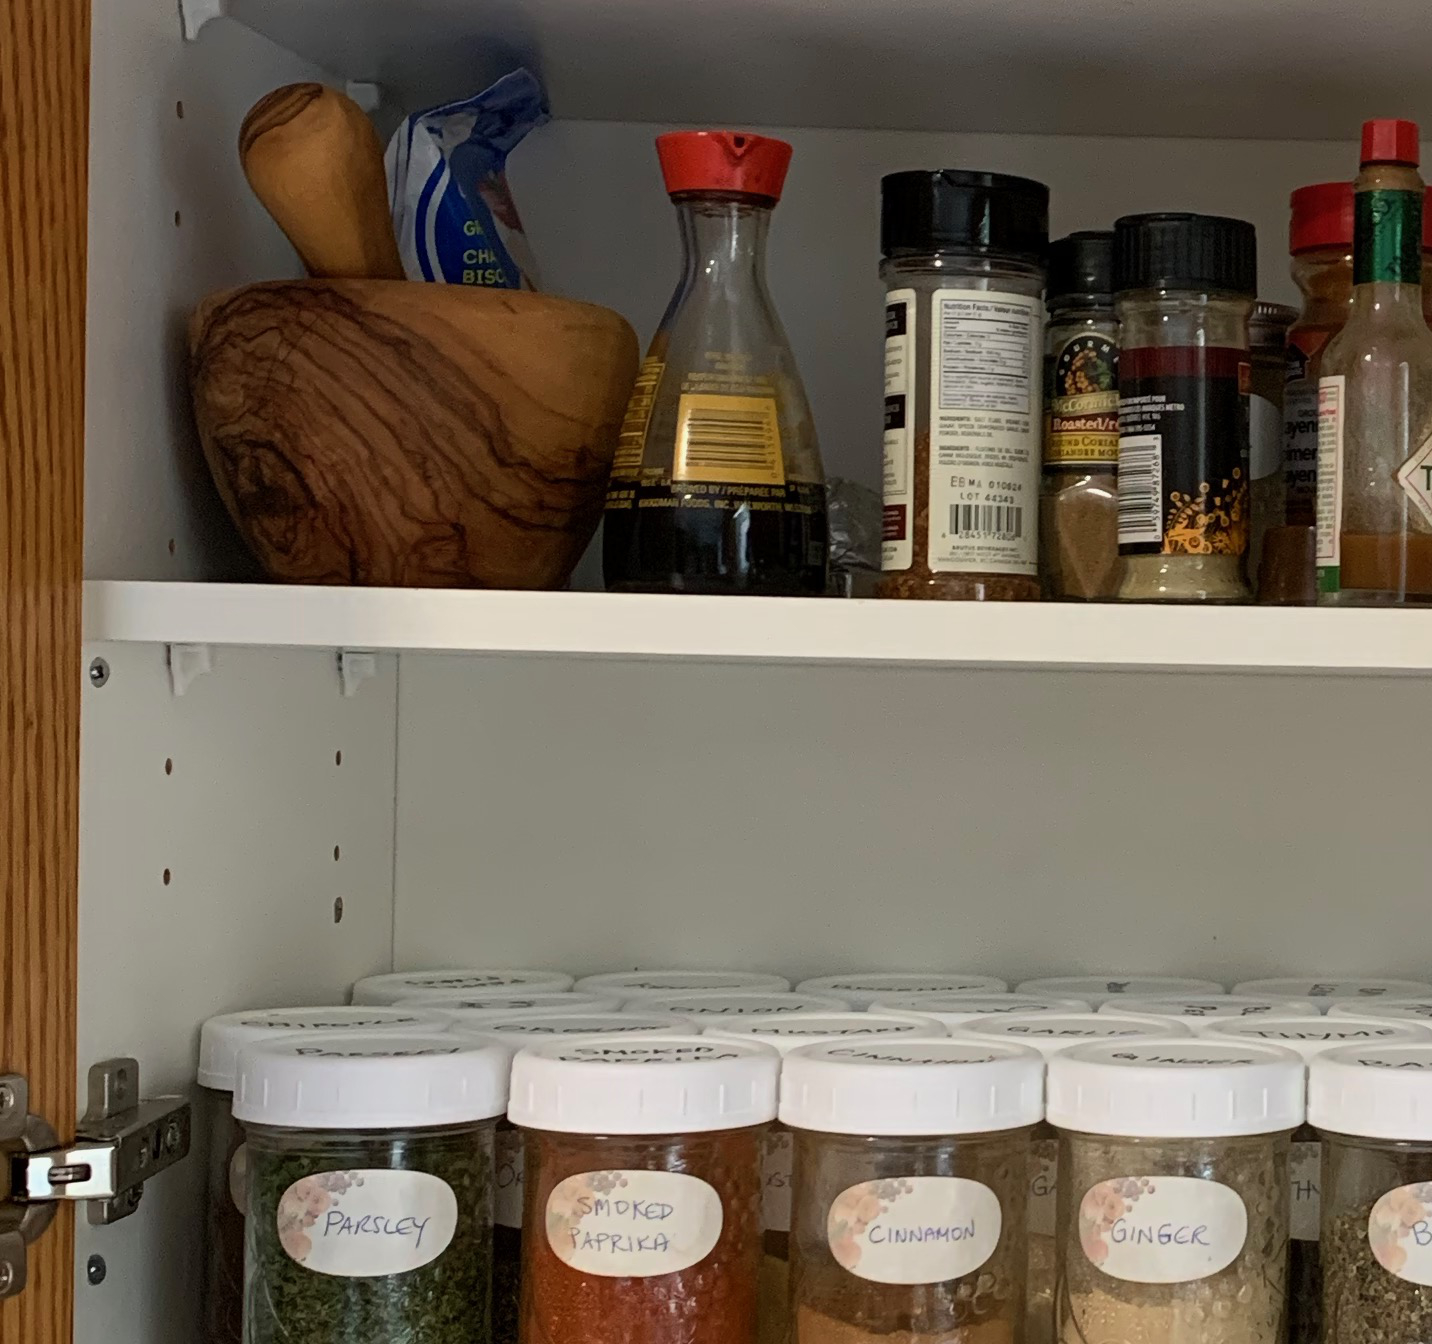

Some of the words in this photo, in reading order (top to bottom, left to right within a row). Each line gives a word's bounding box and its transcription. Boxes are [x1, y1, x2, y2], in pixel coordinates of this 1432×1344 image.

[577, 1197, 674, 1220] SMOKED
[323, 1210, 432, 1249] PARSLEY
[569, 1227, 671, 1254] PAPRIKA
[868, 1219, 976, 1244] CINNAMON
[1111, 1218, 1211, 1246] GINGER
